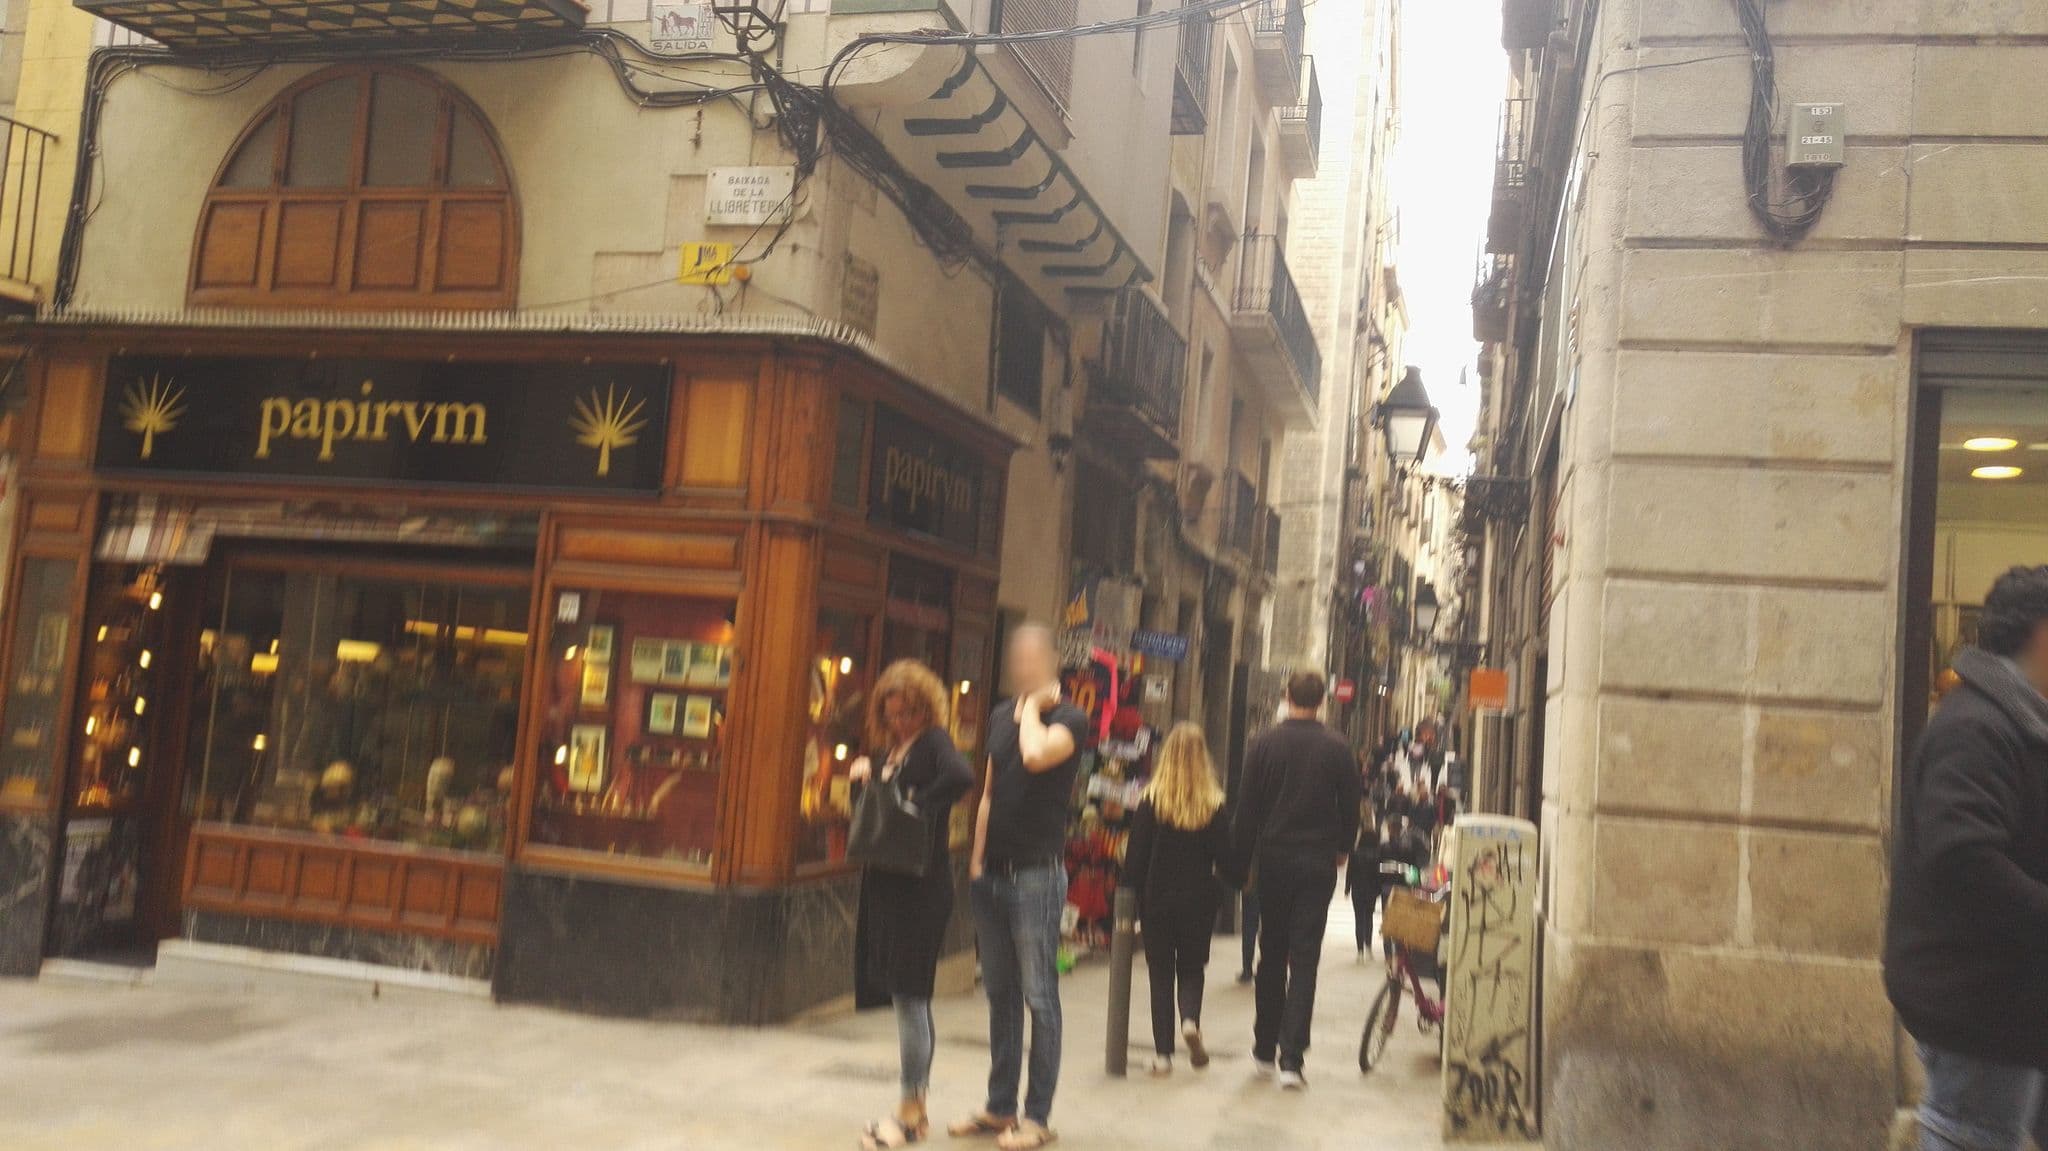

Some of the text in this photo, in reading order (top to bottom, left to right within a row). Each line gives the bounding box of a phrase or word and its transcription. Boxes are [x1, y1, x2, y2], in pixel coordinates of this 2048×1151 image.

[653, 41, 708, 50] SALIDA
[728, 175, 770, 185] BAIXADA
[733, 188, 764, 197] DE LA
[254, 379, 487, 462] papirvm
